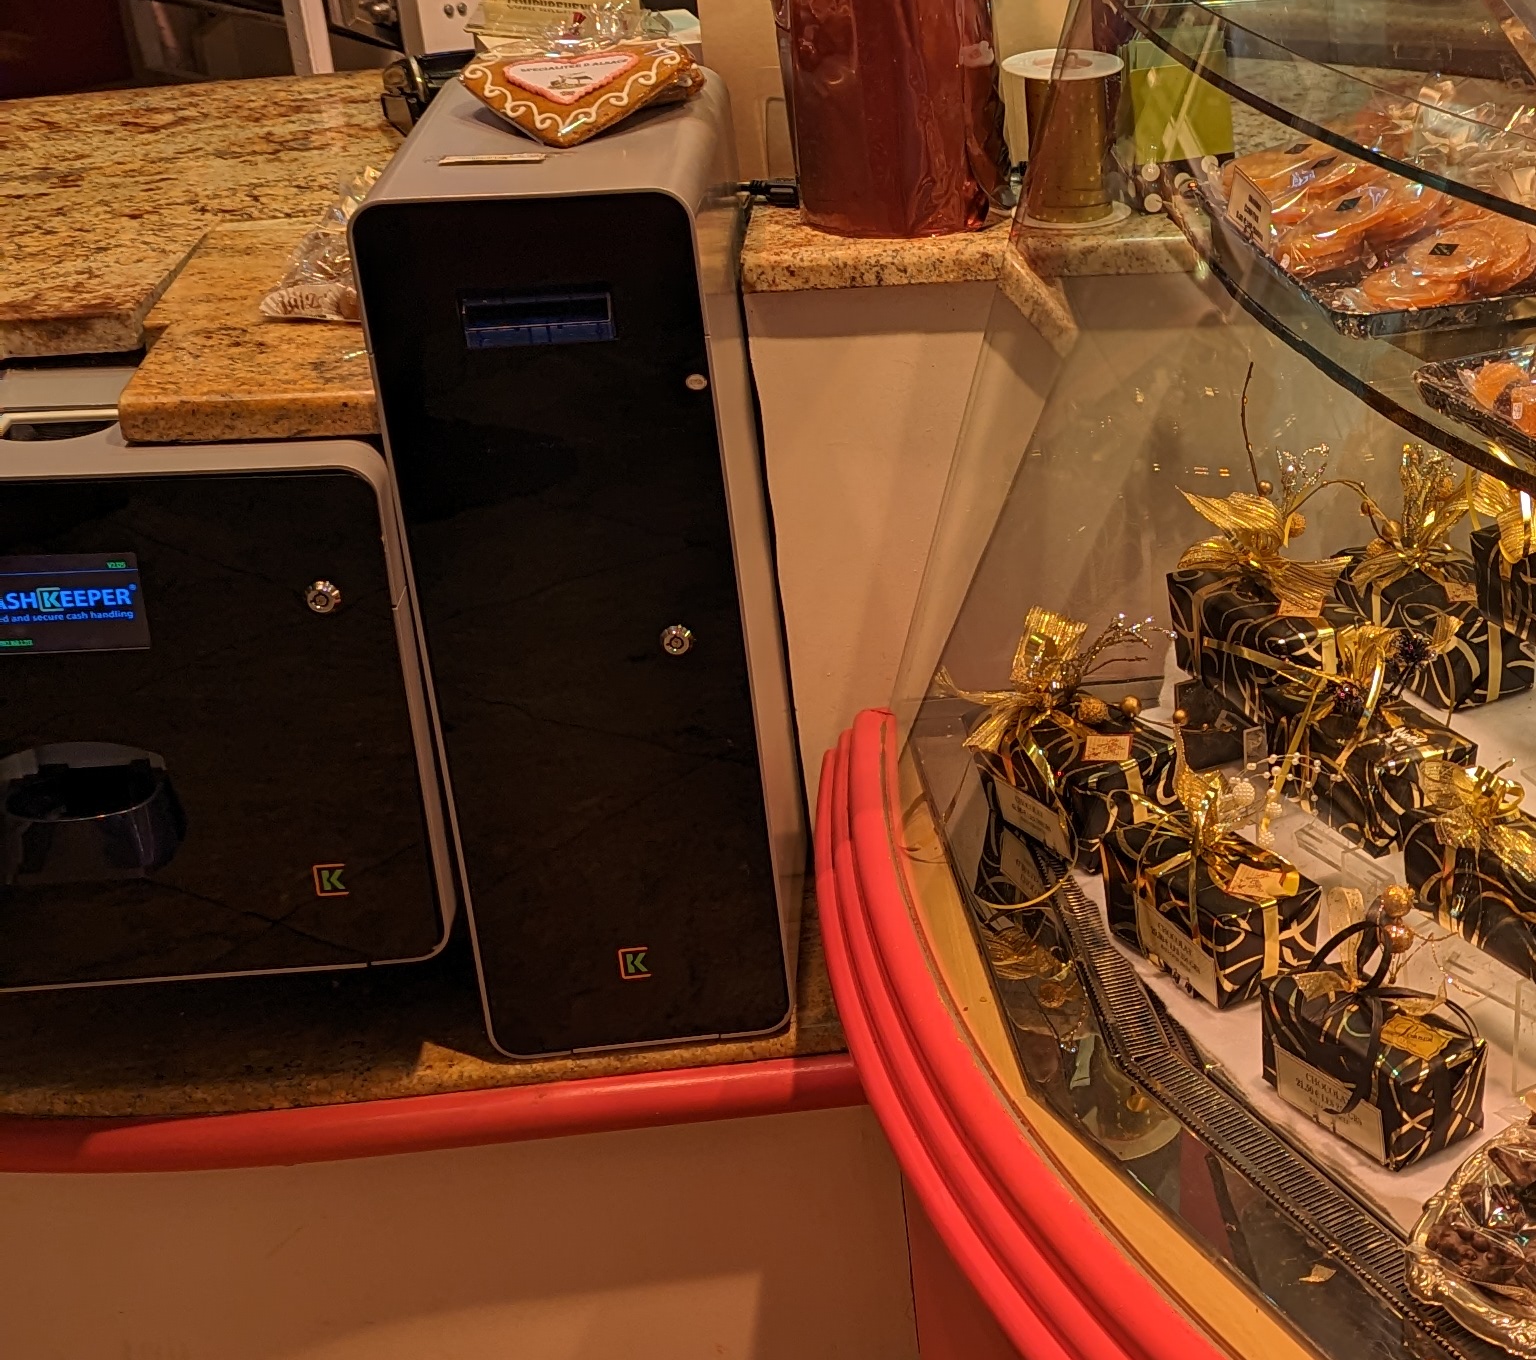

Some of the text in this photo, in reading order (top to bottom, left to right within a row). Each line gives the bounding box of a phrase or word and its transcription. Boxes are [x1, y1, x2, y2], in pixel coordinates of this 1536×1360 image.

[11, 614, 30, 623] and
[32, 614, 65, 622] secure
[66, 611, 88, 620] cash
[90, 610, 134, 620] handling
[1305, 1072, 1349, 1104] CHOCOLA
